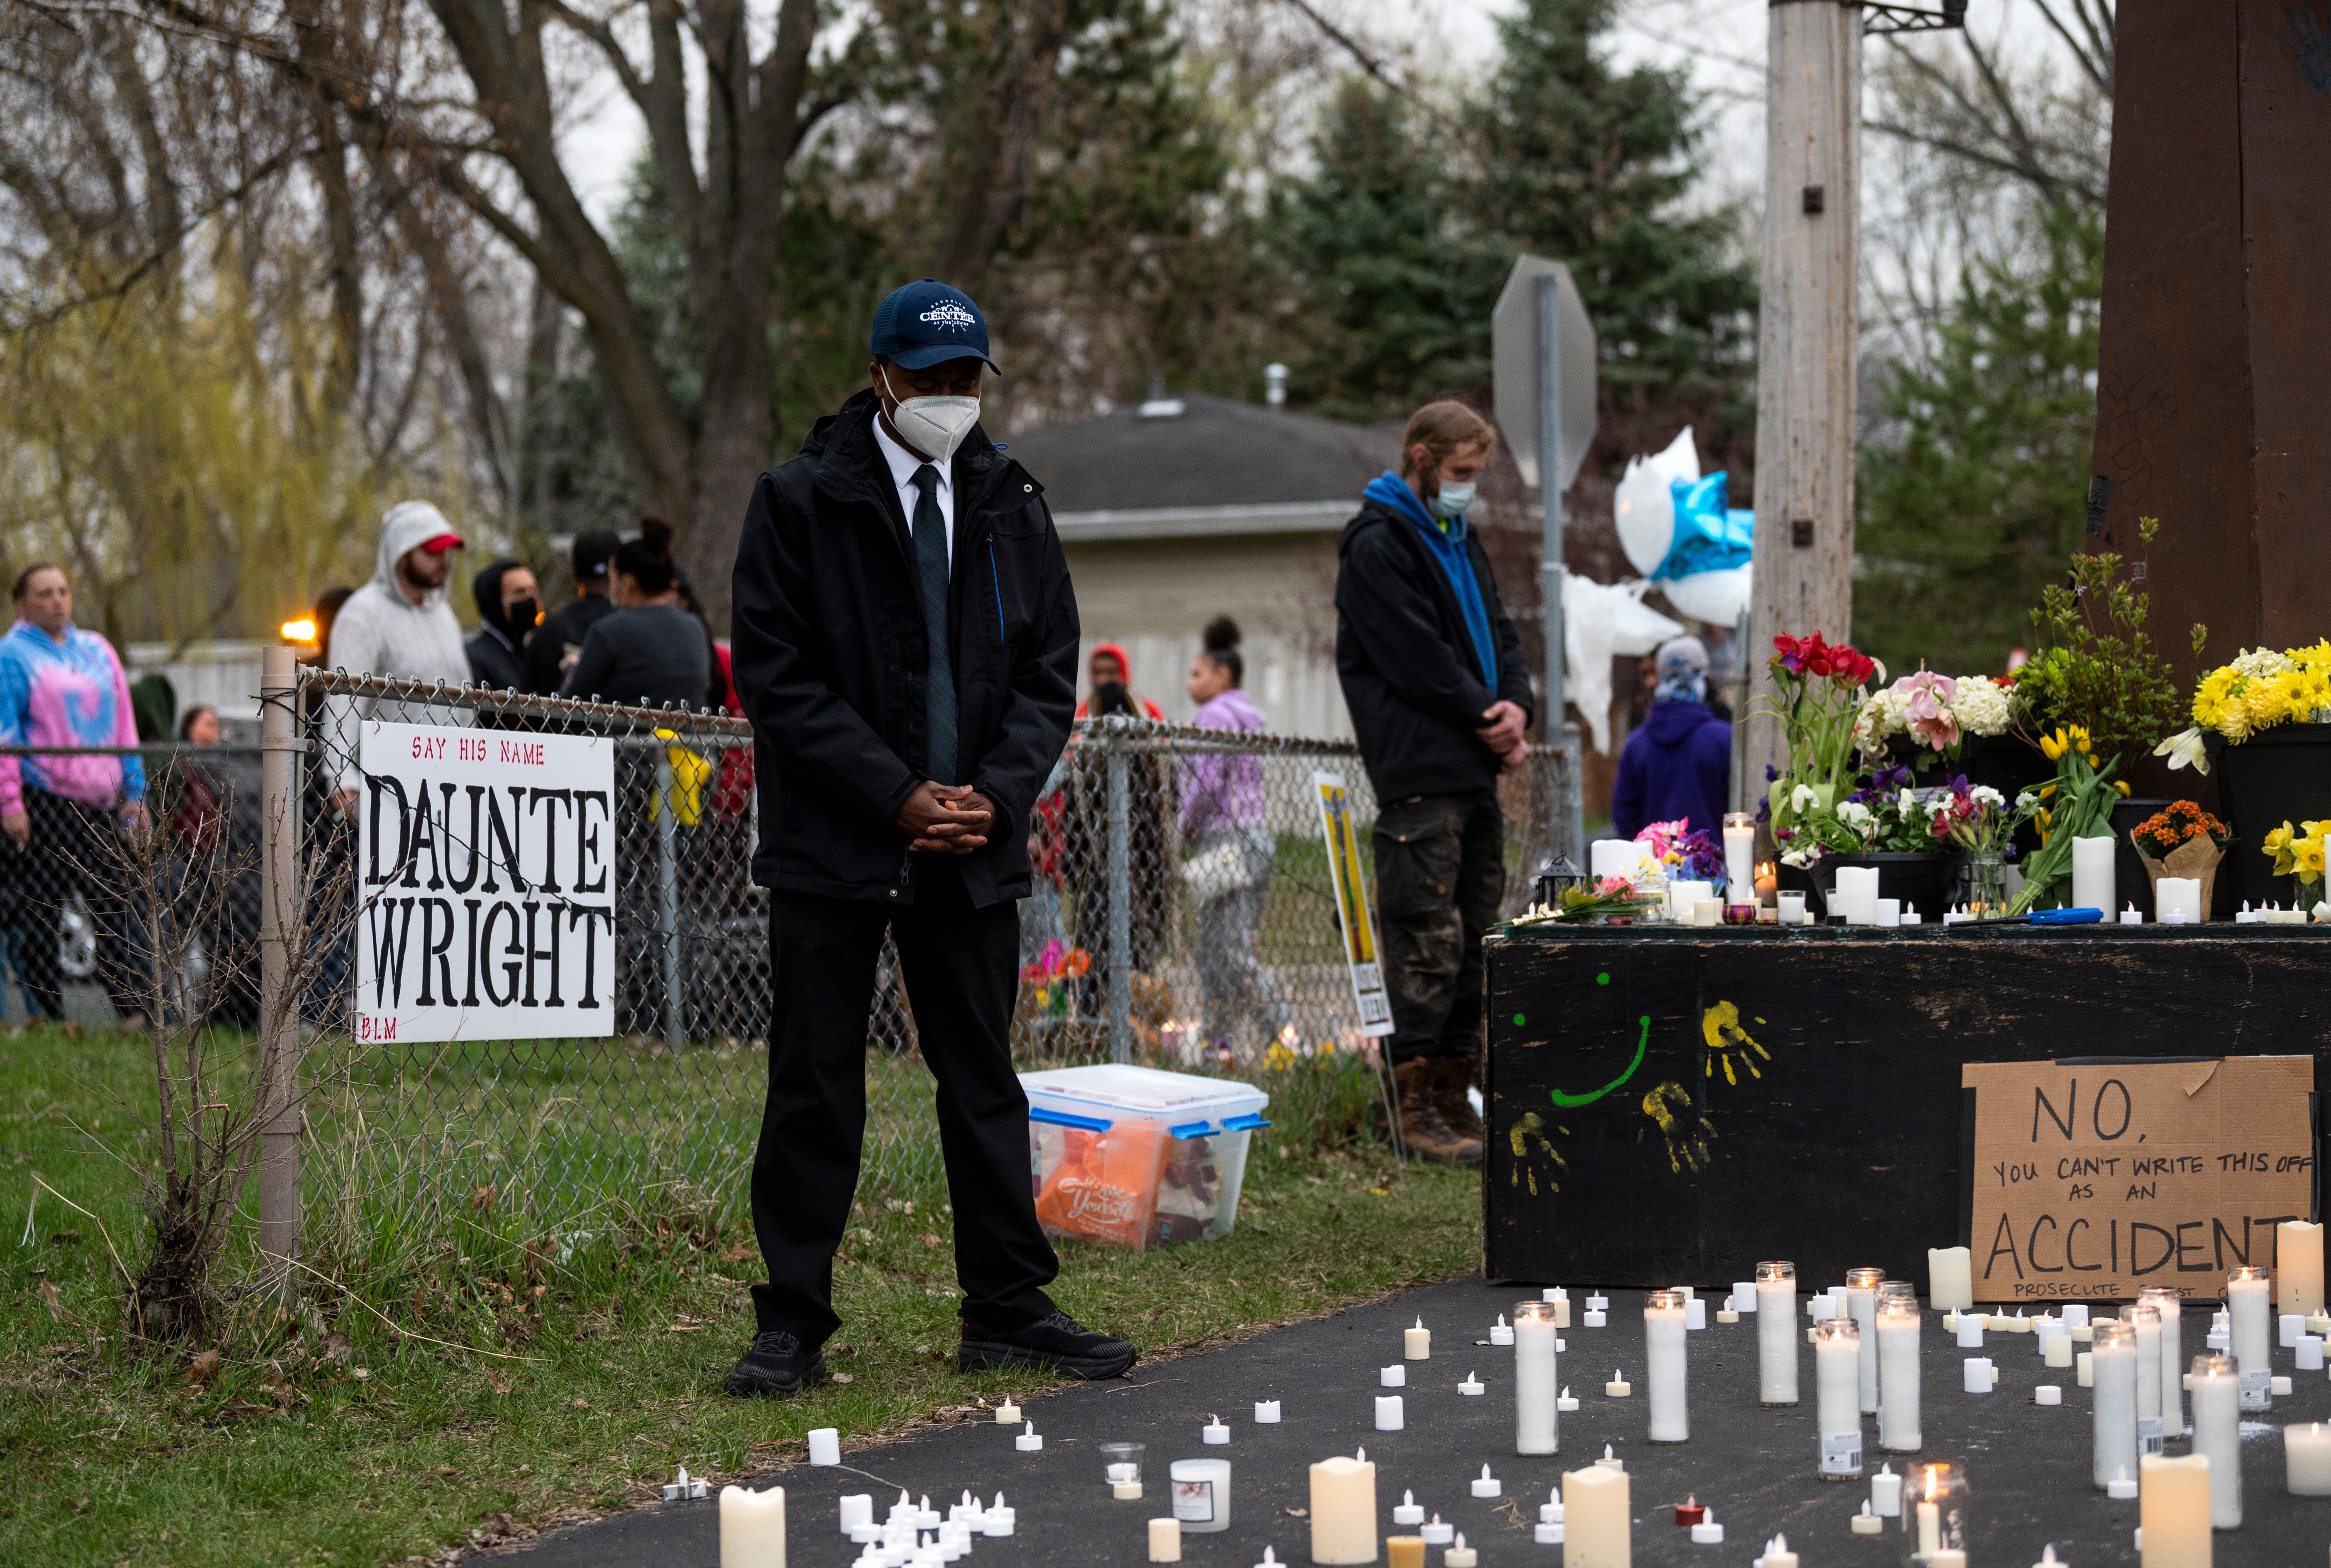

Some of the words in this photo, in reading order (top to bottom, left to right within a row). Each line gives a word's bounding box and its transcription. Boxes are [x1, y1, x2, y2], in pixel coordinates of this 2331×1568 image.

[920, 312, 975, 323] CENTER
[931, 299, 965, 310] BROOKLYN
[412, 736, 446, 760] SAY
[460, 738, 486, 761] HIS
[501, 740, 544, 765] NAME
[364, 774, 609, 895] DAUNTE
[366, 897, 612, 1009] WRIGHT
[362, 1017, 396, 1040] BLM
[2032, 1079, 2146, 1143] NO,
[1993, 1161, 2039, 1187] YOU
[2057, 1157, 2121, 1179] CAN'T
[2133, 1156, 2204, 1176] WRITE
[2217, 1152, 2269, 1172] THIS
[2276, 1156, 2312, 1173] OFF
[2069, 1183, 2094, 1201] AS
[2126, 1181, 2156, 1202] AN
[1983, 1212, 2309, 1279] ACCIDENT
[2013, 1283, 2120, 1297] PROSECUTE
